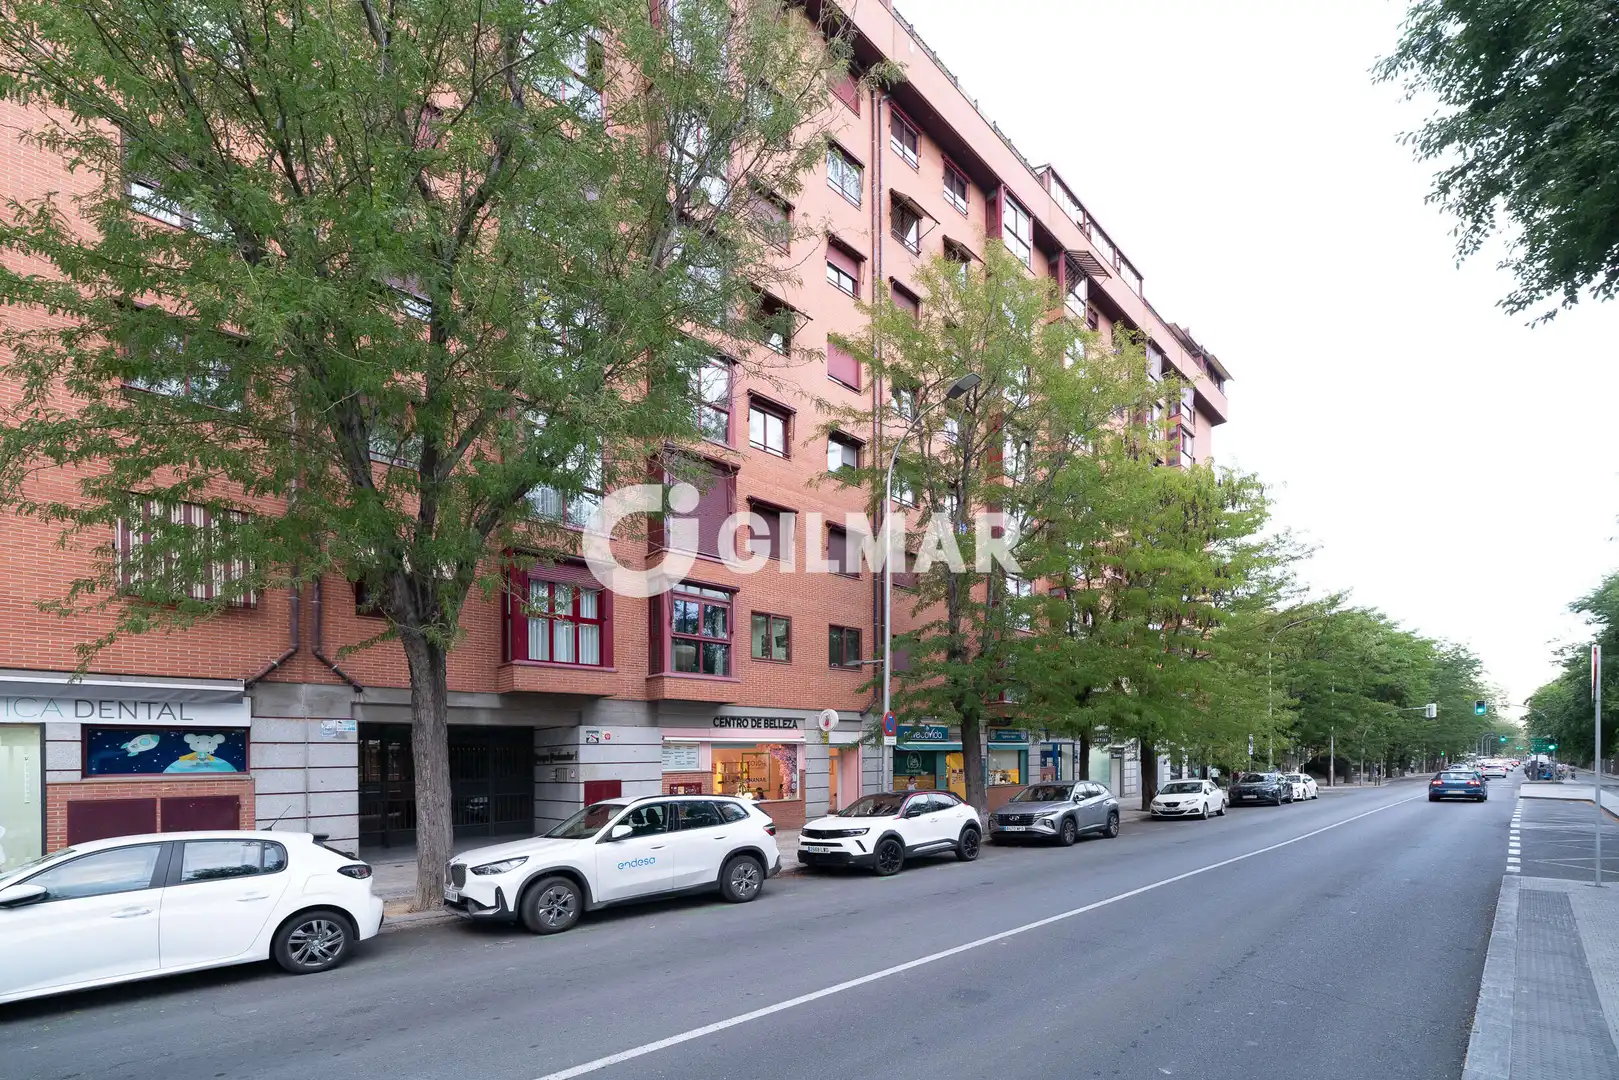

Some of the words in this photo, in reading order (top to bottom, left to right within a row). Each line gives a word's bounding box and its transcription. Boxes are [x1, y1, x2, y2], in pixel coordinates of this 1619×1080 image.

[74, 699, 194, 721] DENTAL
[713, 716, 749, 728] CENTRO
[751, 718, 762, 729] DE
[763, 718, 798, 729] BELLEZA
[617, 857, 656, 870] endesa
